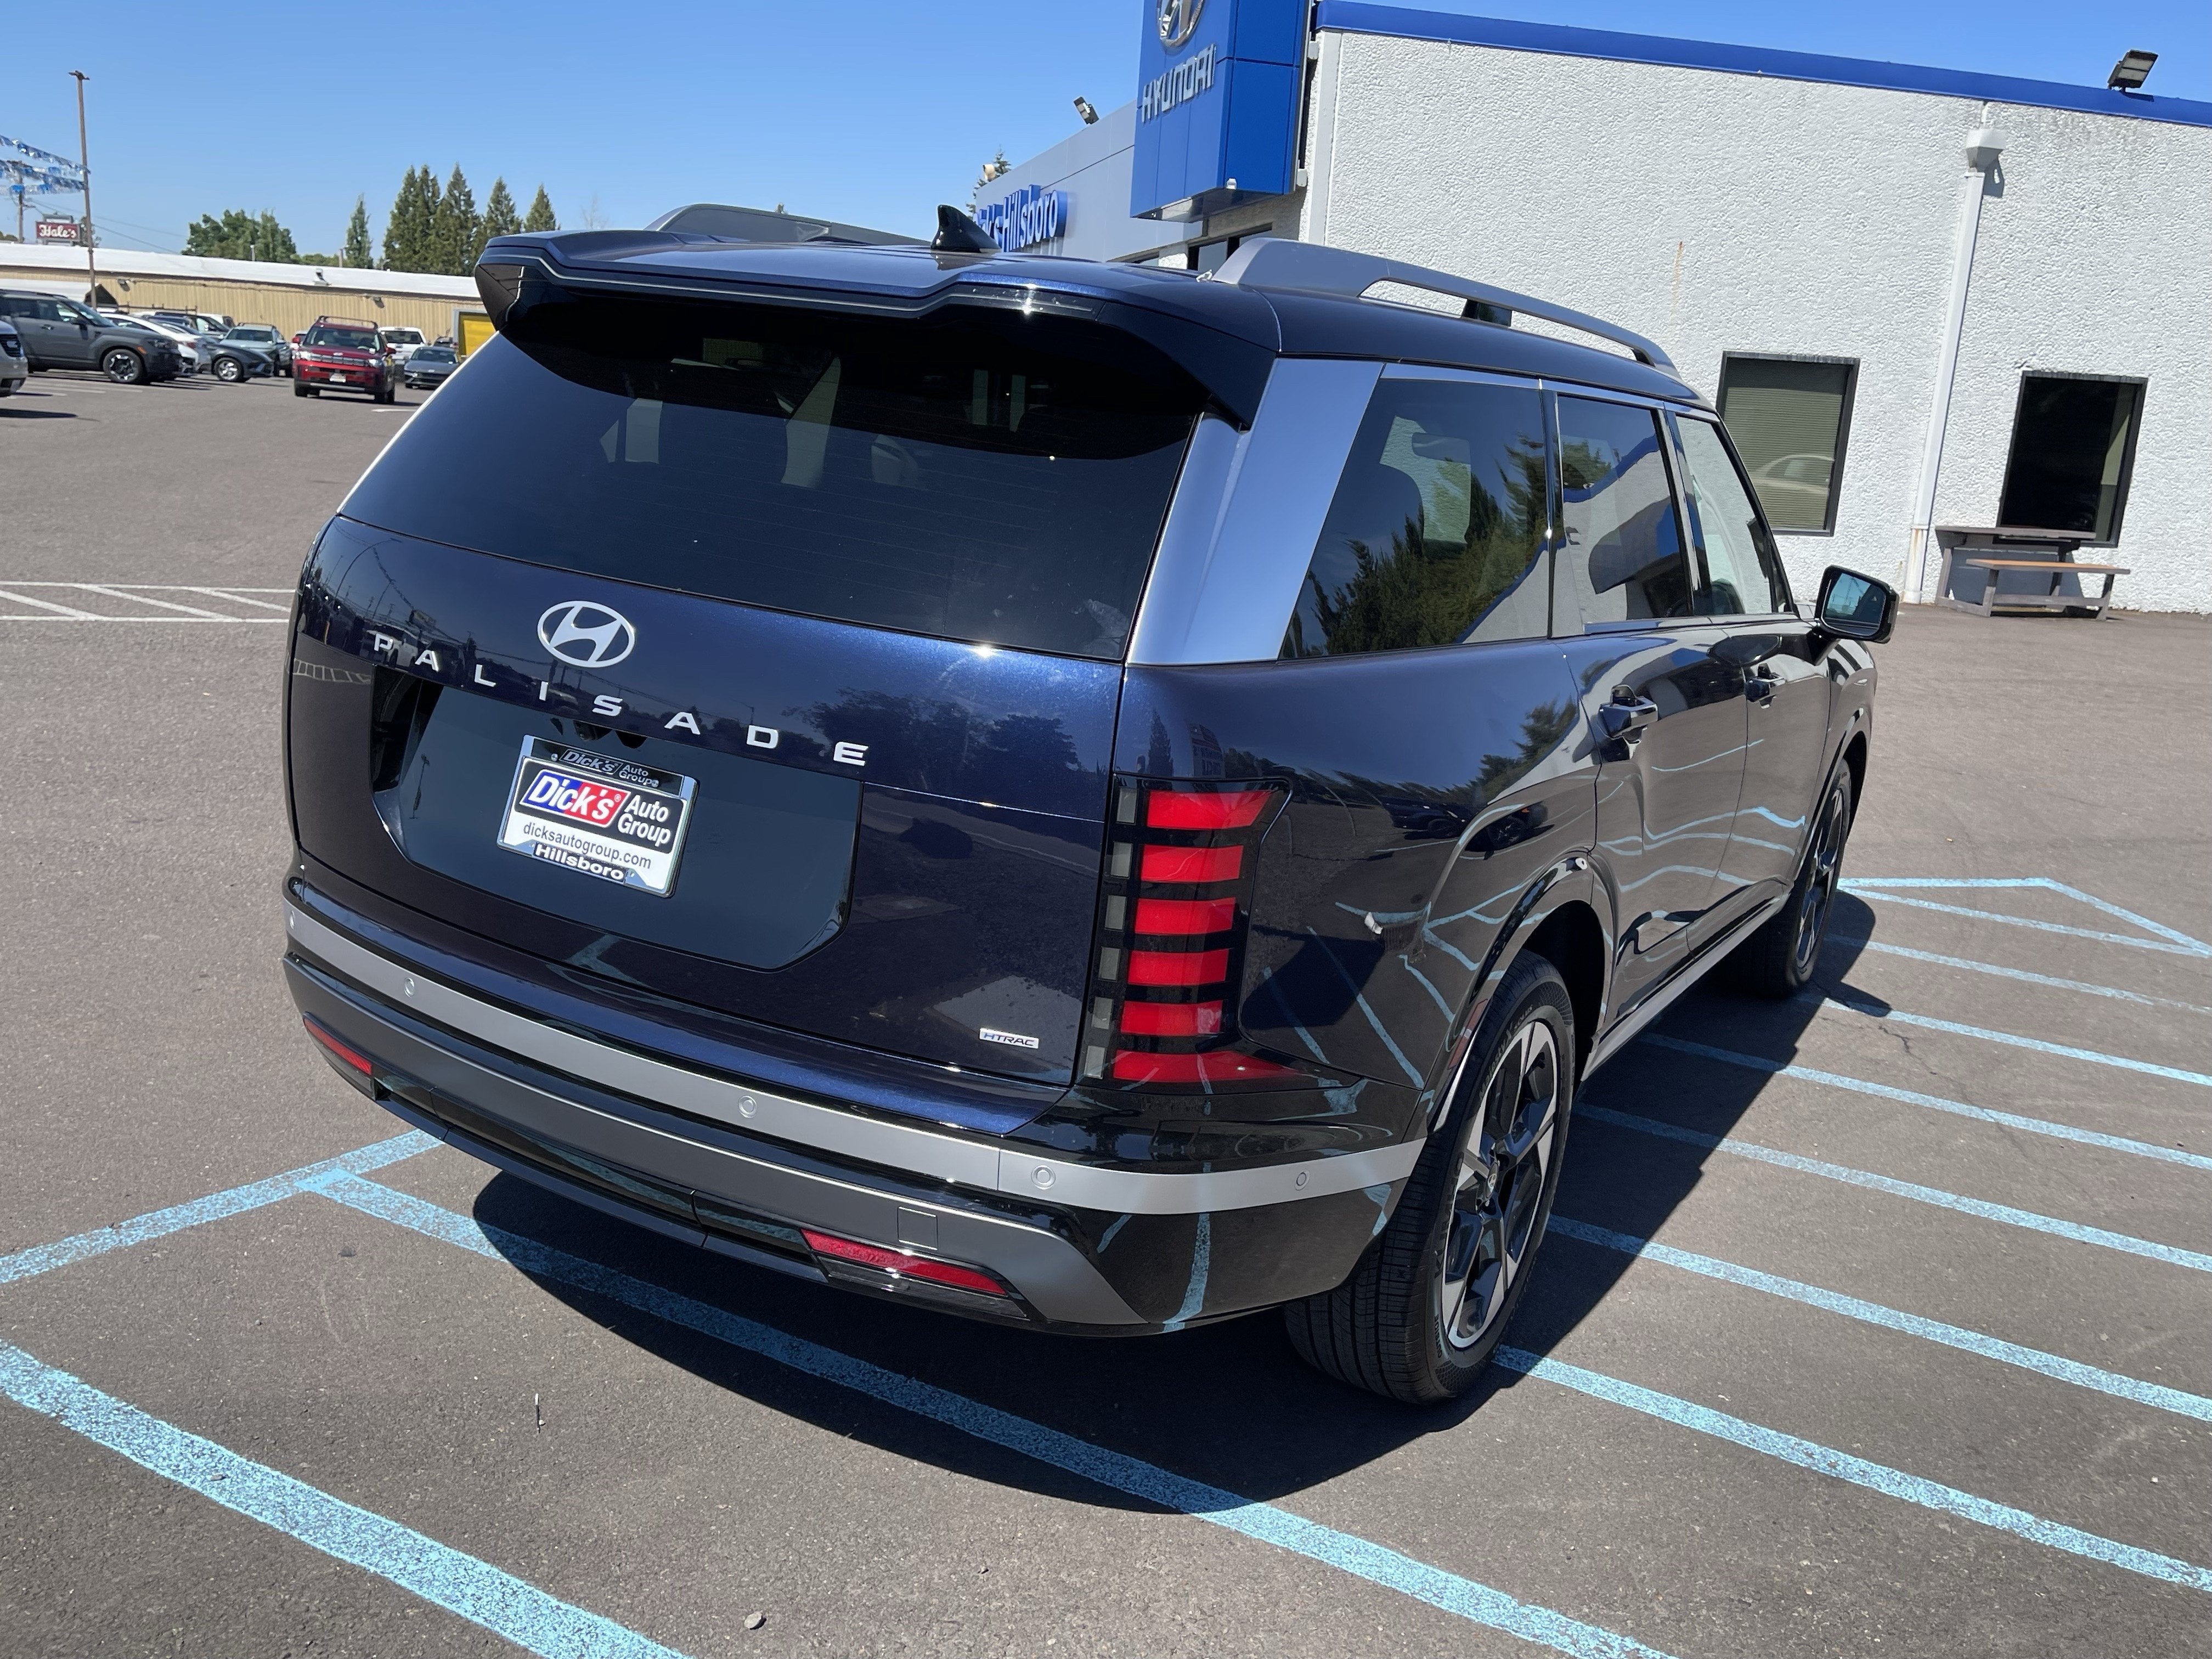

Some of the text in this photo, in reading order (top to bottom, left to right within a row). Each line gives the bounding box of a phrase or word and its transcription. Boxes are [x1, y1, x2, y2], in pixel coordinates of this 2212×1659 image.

[1142, 43, 1217, 124] HYUNDAI
[38, 224, 77, 239] Hale's
[1002, 184, 1068, 252] Hillsboro
[374, 633, 869, 767] PALISADE
[563, 751, 648, 777] Dick's Auto
[618, 770, 653, 786] Group
[528, 776, 669, 822] Dick's Auto
[523, 822, 652, 870] dicksautogroup.com
[618, 814, 671, 847] Group
[534, 844, 624, 881] Hillsboro
[984, 1032, 1035, 1046] HTRAC
